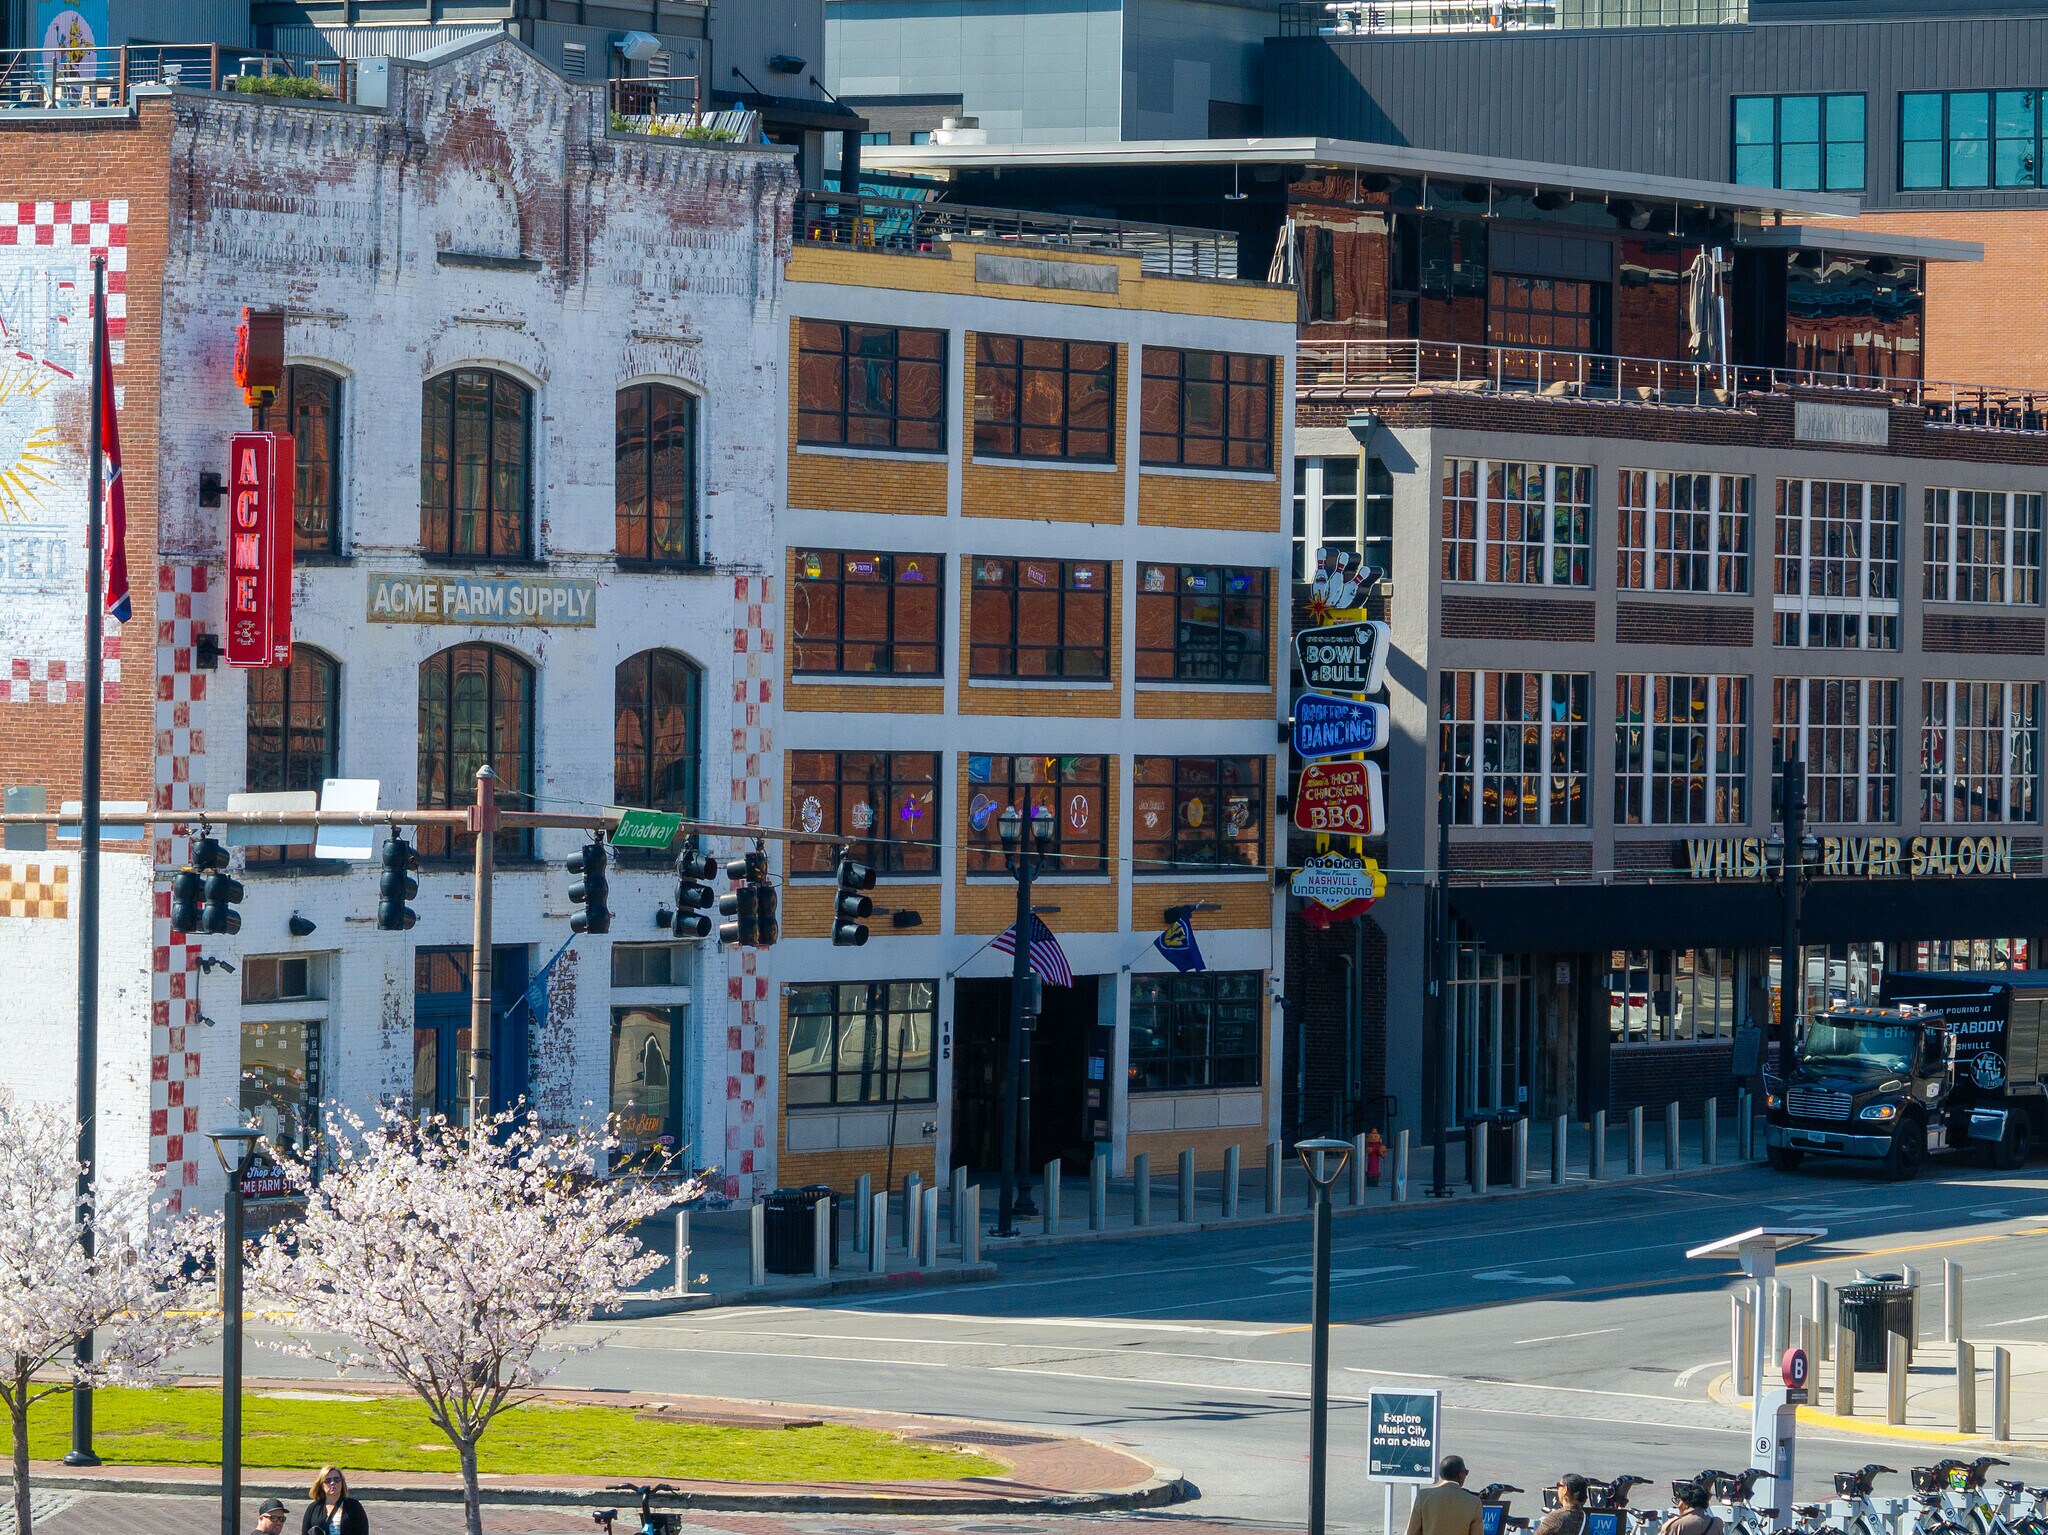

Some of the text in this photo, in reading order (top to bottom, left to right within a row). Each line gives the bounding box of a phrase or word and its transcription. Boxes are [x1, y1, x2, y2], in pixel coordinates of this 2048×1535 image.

[235, 448, 260, 613] ACME
[373, 582, 592, 617] ACME FARM SUPPLY
[1306, 645, 1367, 664] BOWL
[1320, 665, 1365, 682] BULL
[1301, 703, 1349, 722] ROOFTOP
[1301, 719, 1372, 749] DANCING
[1331, 771, 1360, 786] HOT
[1305, 783, 1364, 801] CHICKEN
[1309, 804, 1365, 830] BBQ
[618, 820, 674, 843] Broadway
[1823, 836, 1901, 876] RIVER
[1911, 836, 2013, 876] SALOON
[1335, 860, 1360, 868] THE
[1308, 876, 1358, 886] NASHVILLE
[1293, 885, 1372, 896] UNDERGROUND
[1946, 1006, 1980, 1014] POURING
[1945, 1020, 2005, 1035] PEABODY
[942, 1021, 950, 1059] 105
[1956, 1041, 1991, 1051] SHVILLE
[247, 1166, 269, 1179] Shop
[239, 1180, 256, 1194] CME
[258, 1179, 280, 1192] FARM
[1794, 1358, 1804, 1379] B
[1383, 1413, 1421, 1424] E-xplore
[1378, 1425, 1427, 1437] Music City
[1373, 1437, 1431, 1447] on an e-bike
[1760, 1440, 1767, 1450] B
[1594, 1519, 1612, 1530] JW
